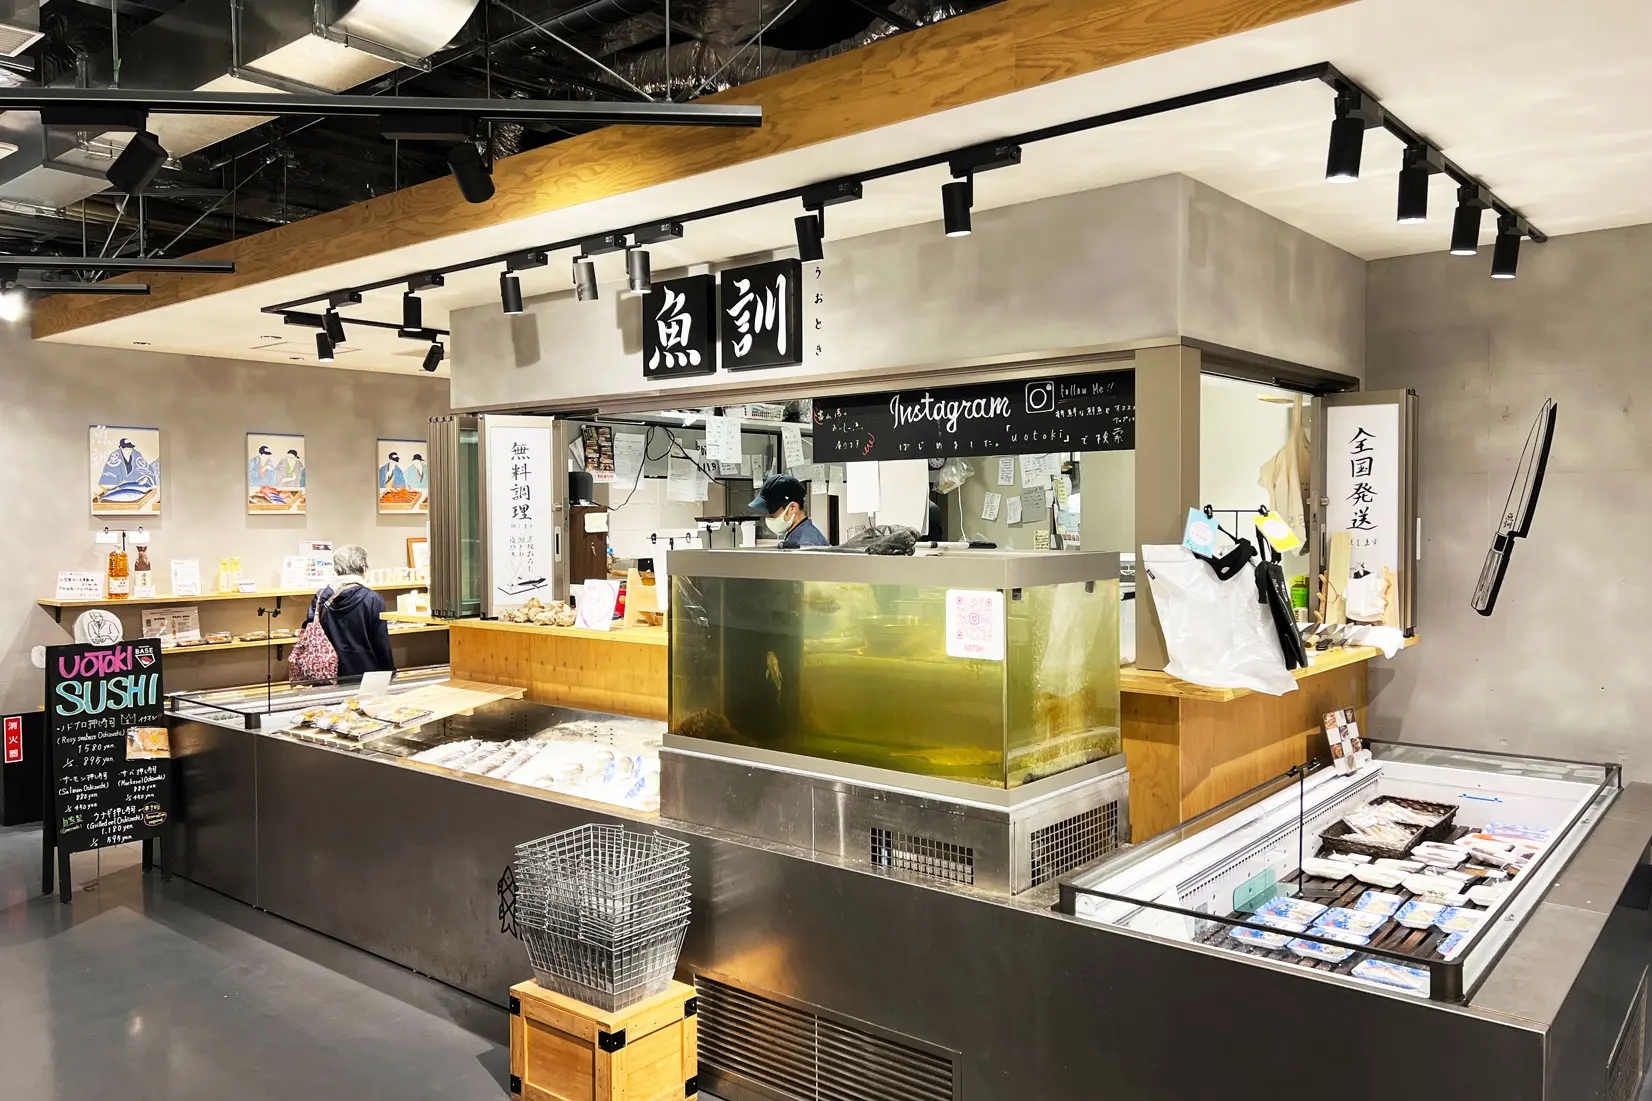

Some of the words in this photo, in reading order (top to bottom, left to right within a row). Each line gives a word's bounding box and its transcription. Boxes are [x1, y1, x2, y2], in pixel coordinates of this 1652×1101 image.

[649, 273, 787, 370] 魚訓
[814, 266, 823, 356] うおとき
[889, 392, 1012, 433] Instagram
[899, 440, 1000, 451] はじめました。
[510, 441, 532, 520] 無料調理
[1346, 427, 1378, 530] 全国発送
[135, 647, 153, 655] BASE
[55, 673, 159, 716] SUSHI
[8, 721, 19, 758] 消火器
